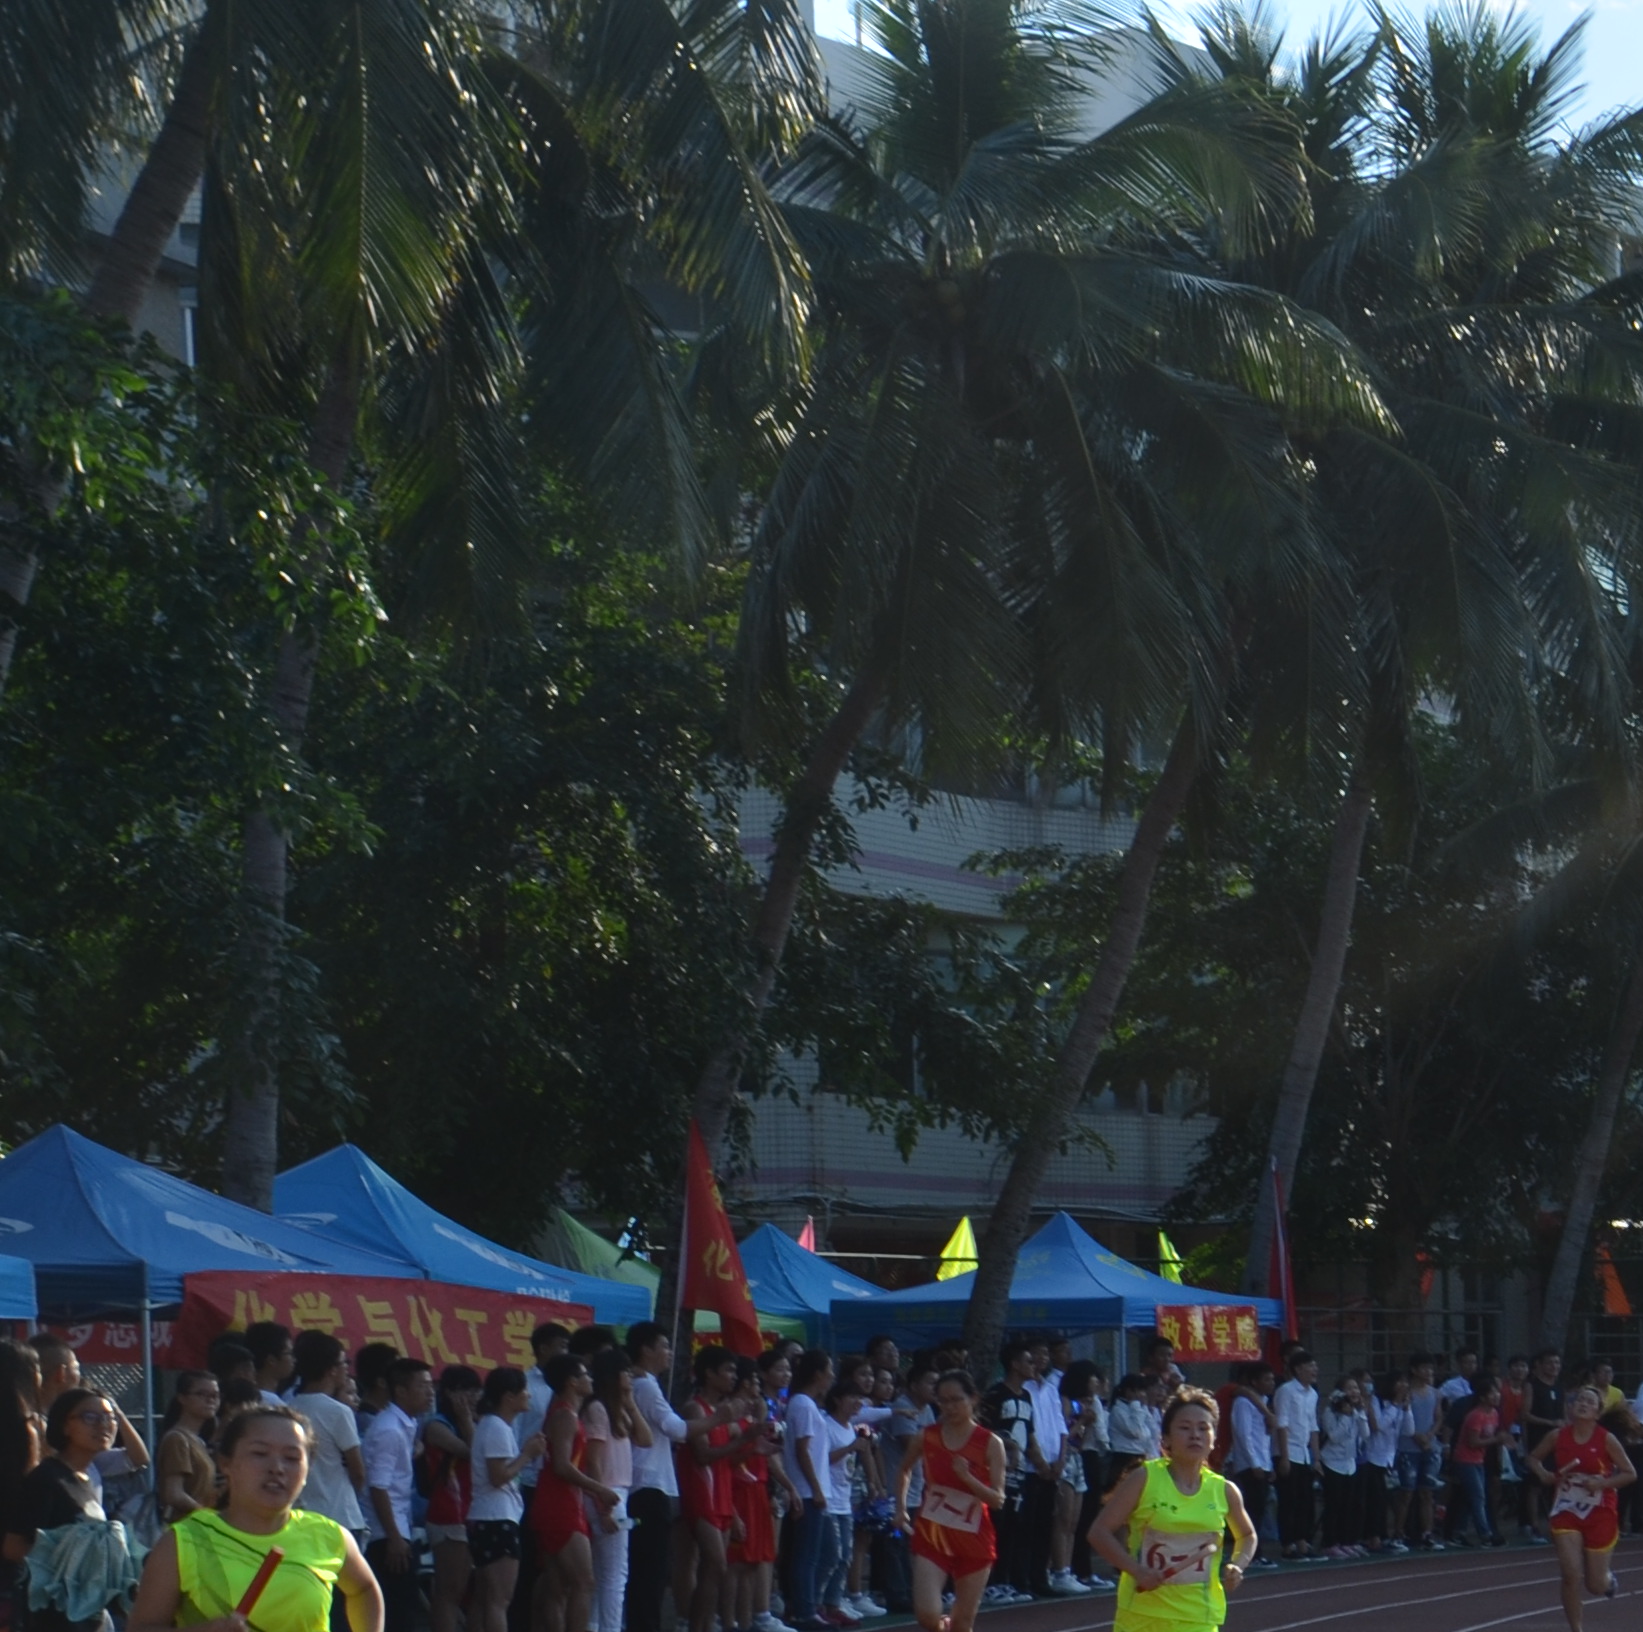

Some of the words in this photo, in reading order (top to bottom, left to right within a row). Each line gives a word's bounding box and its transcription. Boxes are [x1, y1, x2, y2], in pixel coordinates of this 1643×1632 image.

[226, 1290, 580, 1369] 化学与化工学
[930, 1491, 978, 1524] 7-1
